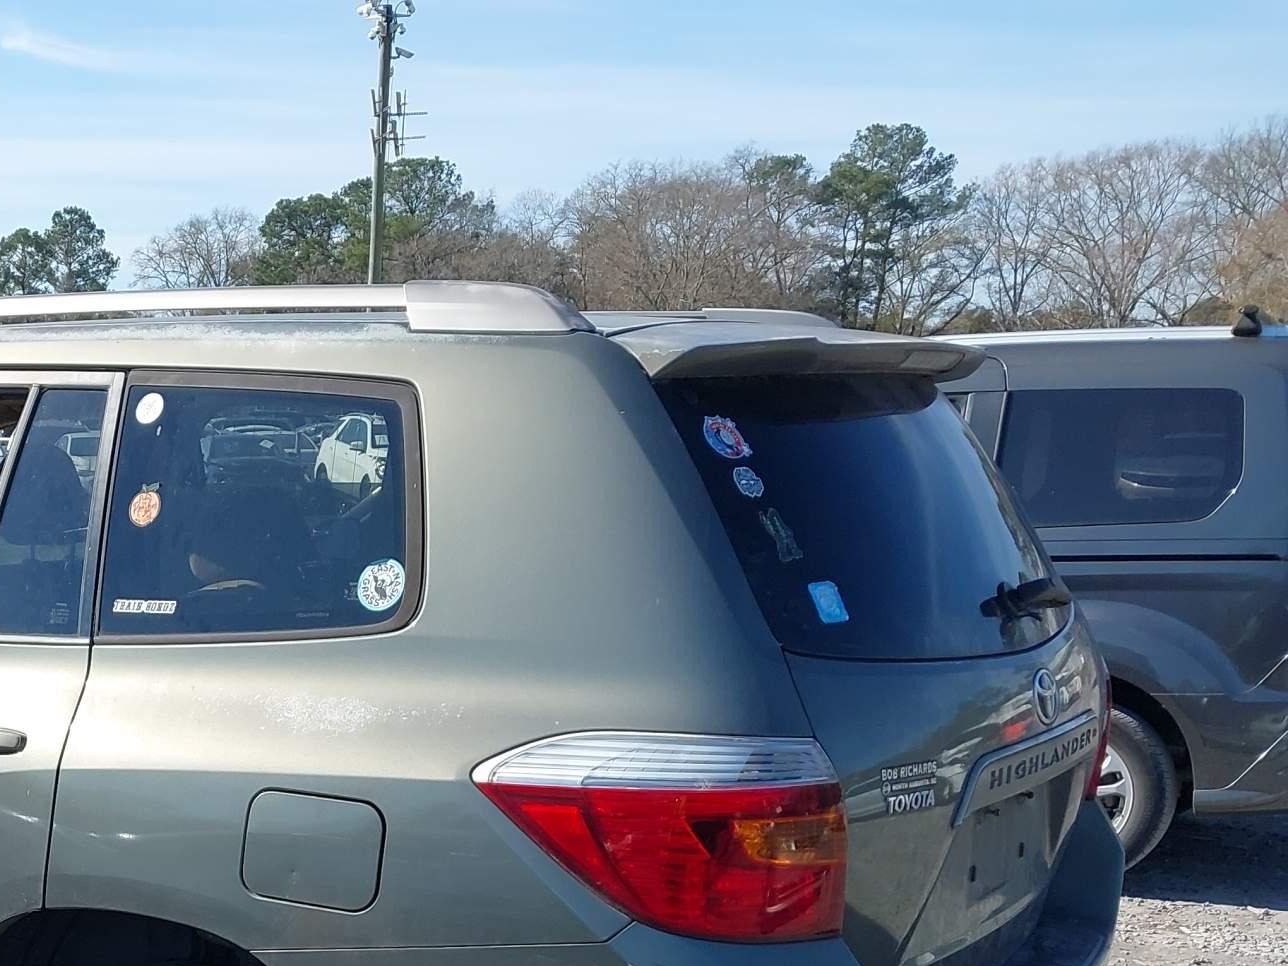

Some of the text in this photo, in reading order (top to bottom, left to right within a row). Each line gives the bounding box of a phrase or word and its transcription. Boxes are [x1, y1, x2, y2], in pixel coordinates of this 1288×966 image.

[370, 564, 395, 575] EAST
[361, 578, 380, 607] GRASS
[387, 571, 402, 601] NASH
[881, 761, 937, 781] BOB RICHARDS
[989, 728, 1091, 790] HIGHLANDER
[887, 789, 936, 815] TOYOTA
